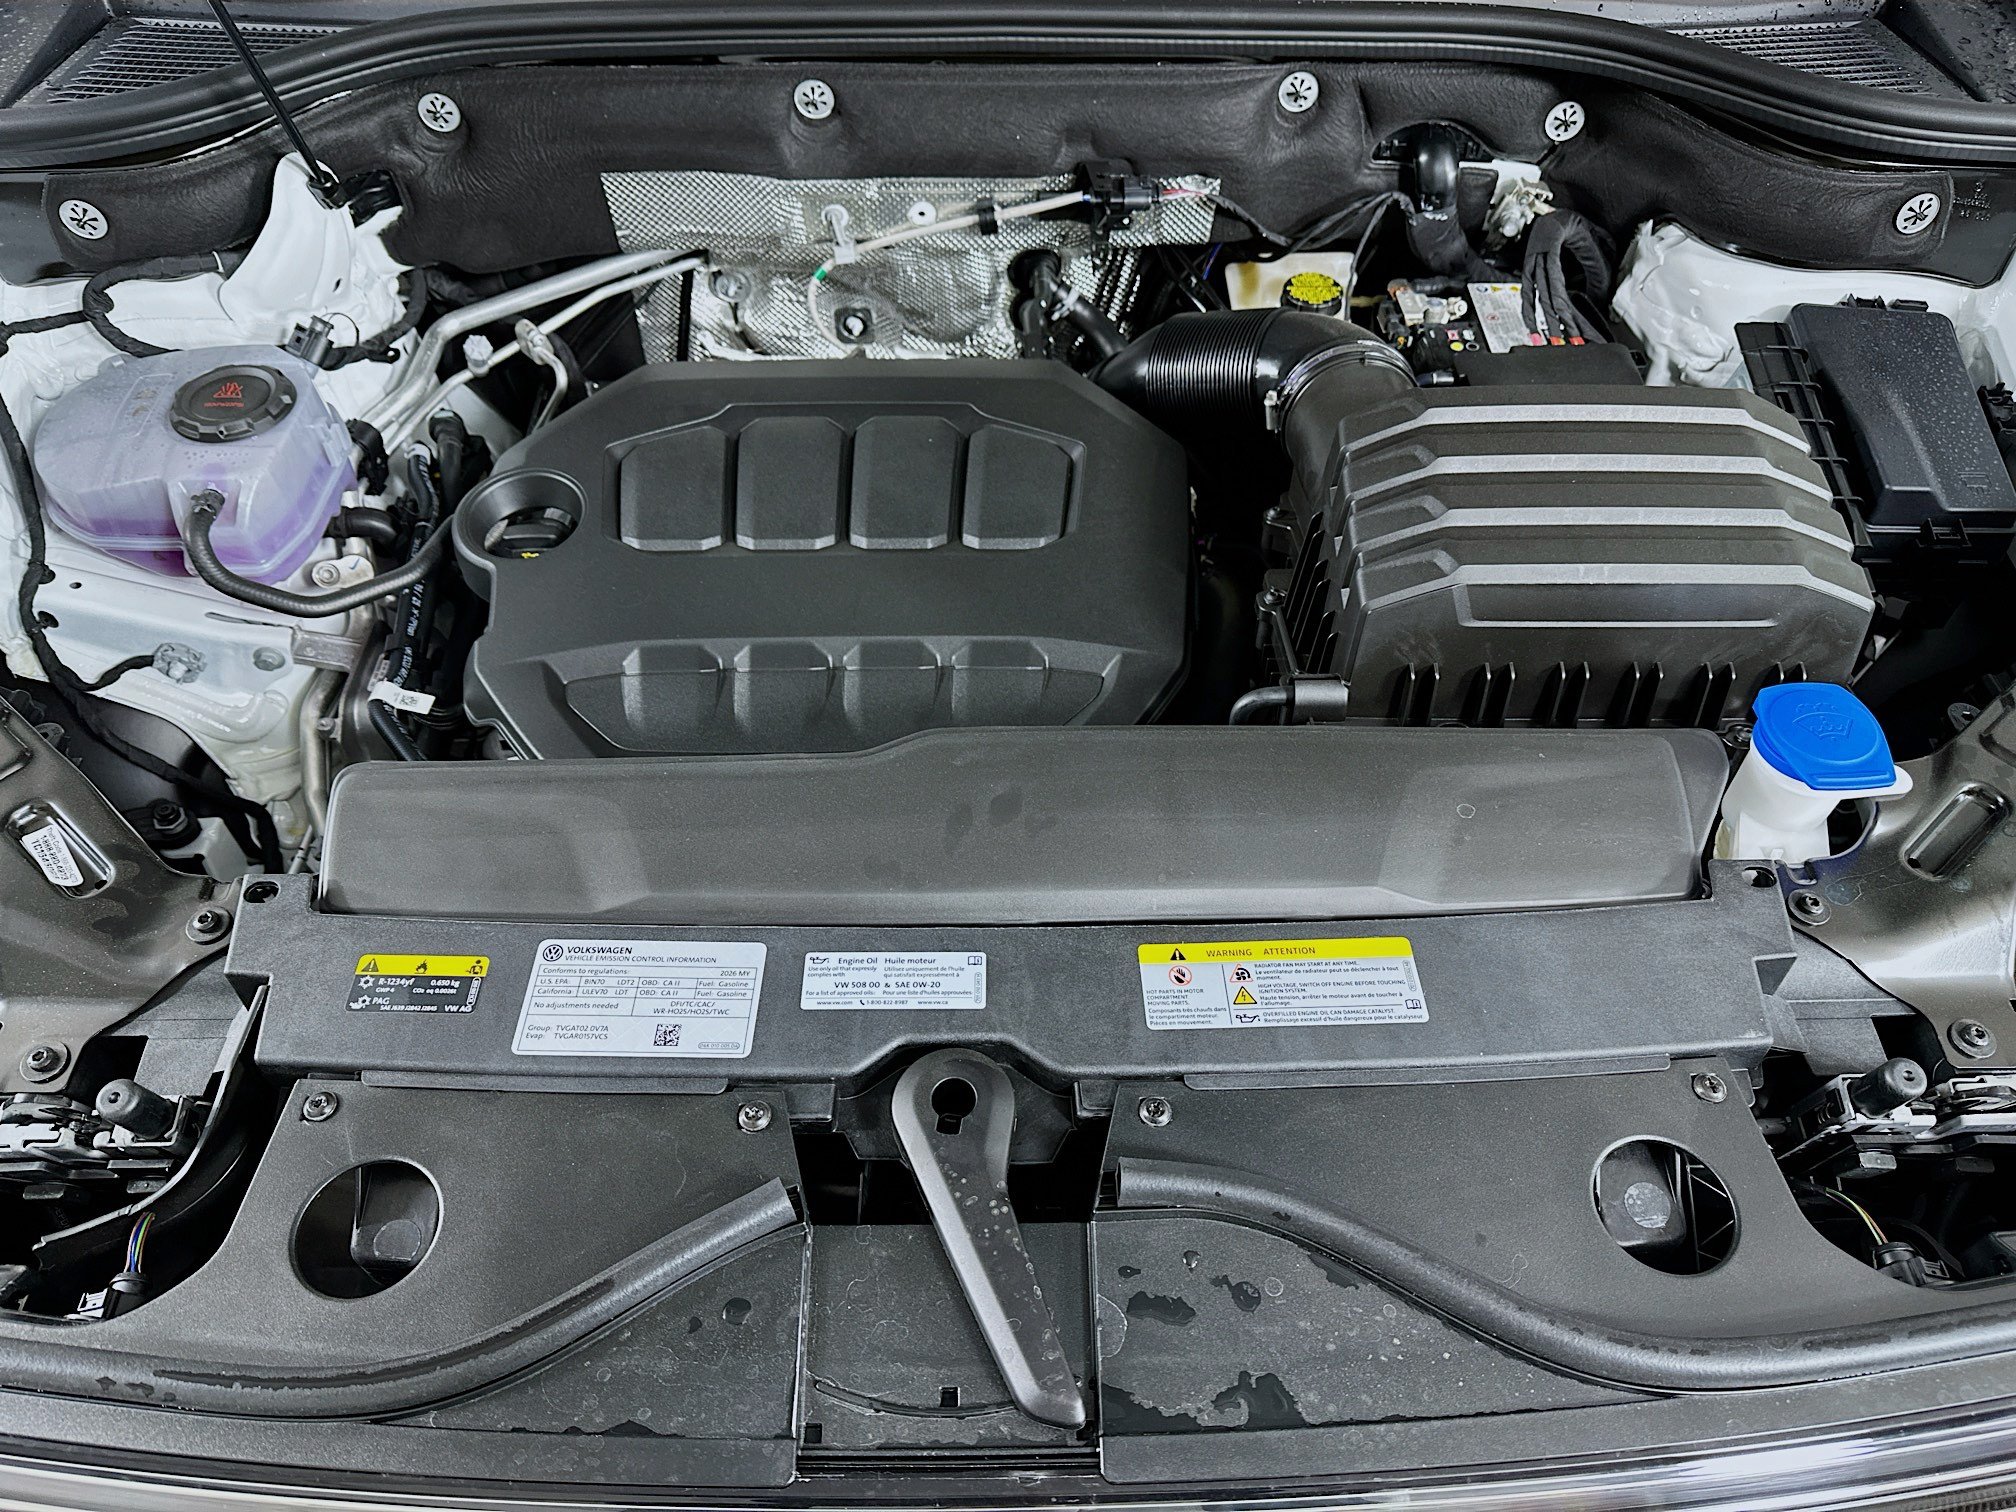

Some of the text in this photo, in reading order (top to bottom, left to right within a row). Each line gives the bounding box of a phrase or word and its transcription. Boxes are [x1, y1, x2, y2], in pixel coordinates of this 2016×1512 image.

[1206, 946, 1316, 957] WARNING ATTENTION
[378, 978, 415, 987] R-1234yf
[546, 1002, 590, 1010] adjustments
